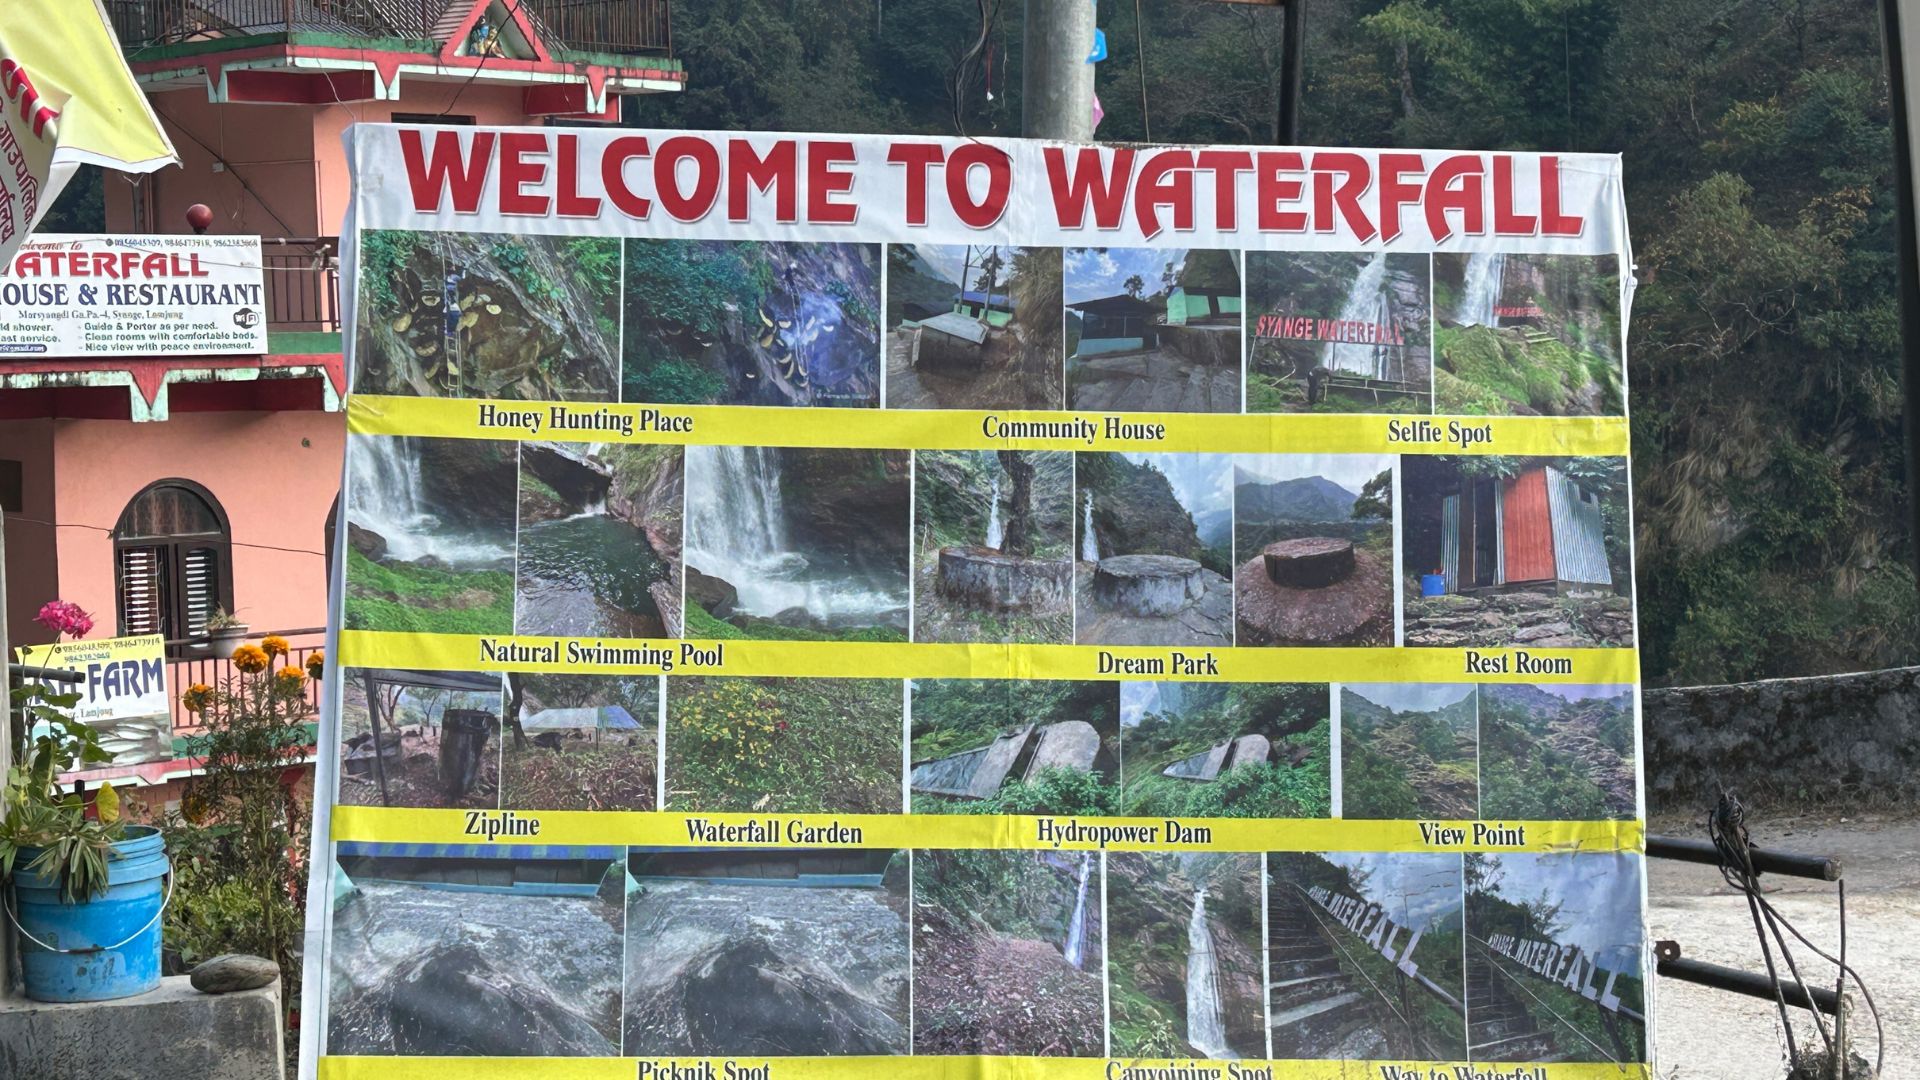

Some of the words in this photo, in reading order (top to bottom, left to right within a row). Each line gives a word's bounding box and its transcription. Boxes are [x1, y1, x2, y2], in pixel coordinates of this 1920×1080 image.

[399, 129, 860, 224] WELCOME
[888, 143, 1012, 229] TO
[1043, 146, 1585, 246] WATERFALL
[20, 240, 64, 250] elcome
[0, 283, 69, 305] OUSE
[78, 283, 98, 305] &
[106, 284, 261, 306] RESTAURANT
[1255, 314, 1313, 339] SYANGE
[85, 343, 108, 351] Nice
[479, 404, 543, 433] Honey
[550, 407, 634, 437] Hunting
[640, 412, 693, 434] Place
[982, 415, 1099, 443] Community
[1104, 417, 1165, 440] House
[1388, 419, 1443, 443] Selfie
[1448, 421, 1492, 448] Spot
[480, 638, 560, 663] Natural
[567, 643, 674, 671] Swimming
[679, 643, 724, 666] Pool
[1098, 651, 1164, 675] Dream
[1171, 652, 1219, 676] Park
[1465, 650, 1509, 673] Rest
[1515, 651, 1573, 674] Room
[88, 658, 164, 703] FARM
[465, 811, 539, 840] Zipline
[686, 818, 780, 843] Waterfall
[786, 820, 863, 844] Garden
[1036, 819, 1158, 848] Hydropower
[1165, 822, 1212, 844] Dam
[1419, 823, 1467, 846] View
[1473, 823, 1525, 846] Point
[638, 1061, 717, 1080] Picknik
[724, 1061, 770, 1080] Spot
[1105, 1061, 1221, 1080] Canyoining
[1227, 1063, 1272, 1080] Spot
[1429, 1068, 1449, 1080] to
[1453, 1067, 1548, 1080] Waterfall
